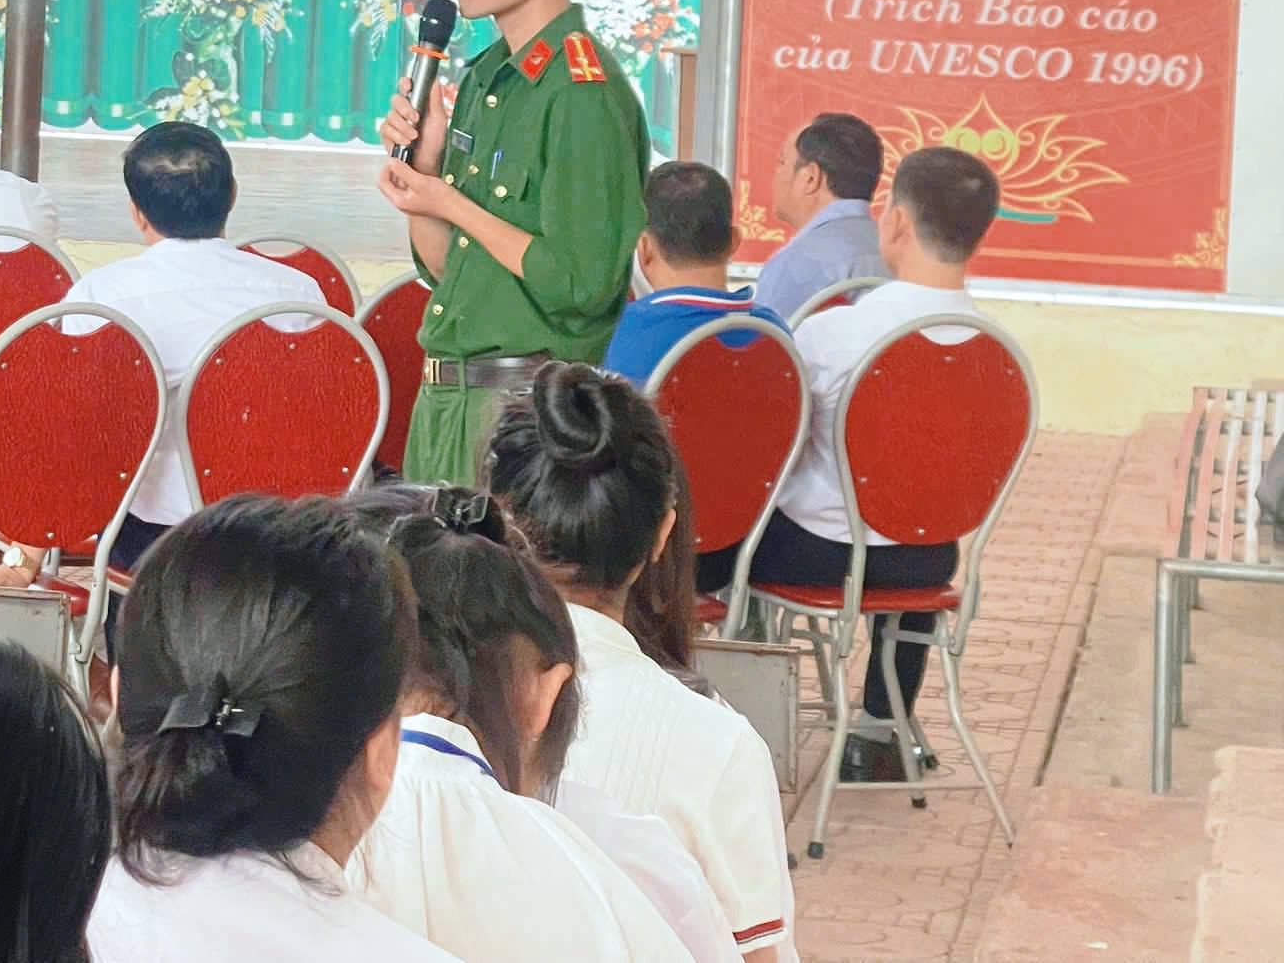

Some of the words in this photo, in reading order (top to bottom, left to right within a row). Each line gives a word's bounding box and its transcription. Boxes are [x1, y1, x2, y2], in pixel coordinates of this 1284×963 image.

[773, 33, 853, 72] của
[869, 38, 1074, 82] UNESCO
[1085, 50, 1204, 92] 1996)
